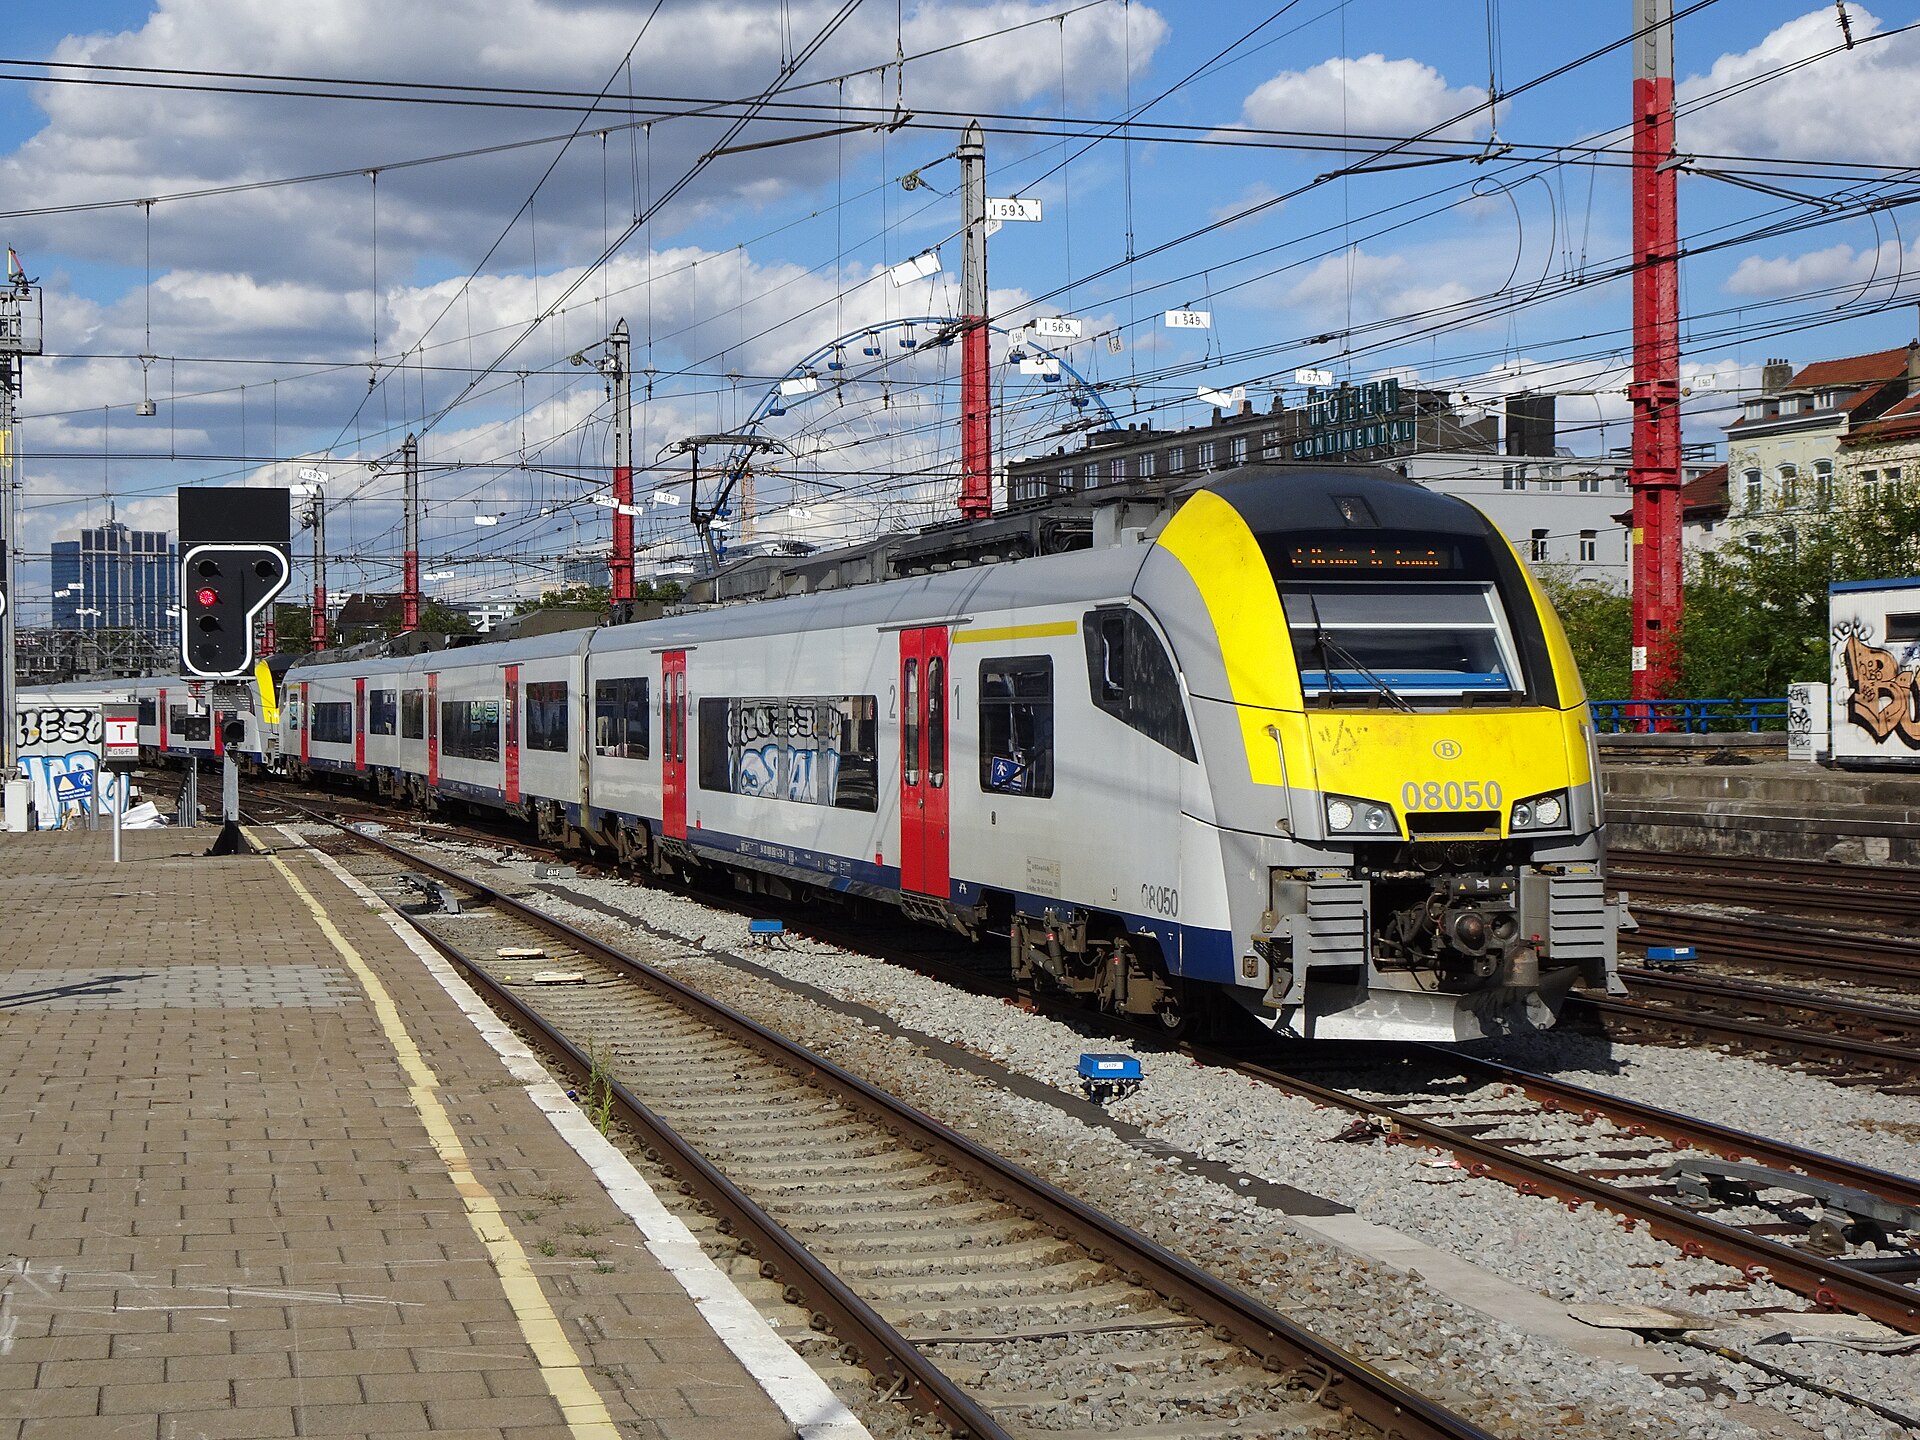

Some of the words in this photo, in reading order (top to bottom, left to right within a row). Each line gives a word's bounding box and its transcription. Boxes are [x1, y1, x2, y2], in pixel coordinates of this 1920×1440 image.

[1001, 204, 1025, 217] 593
[1052, 322, 1071, 333] 569
[1307, 373, 1321, 382] 571
[1310, 383, 1392, 426] HOTEL
[1294, 421, 1410, 456] CONTINENTAL
[889, 684, 896, 719] 2
[954, 684, 960, 720] 1
[116, 724, 127, 740] T
[1401, 780, 1503, 811] 08050
[1141, 883, 1178, 917] 08050
